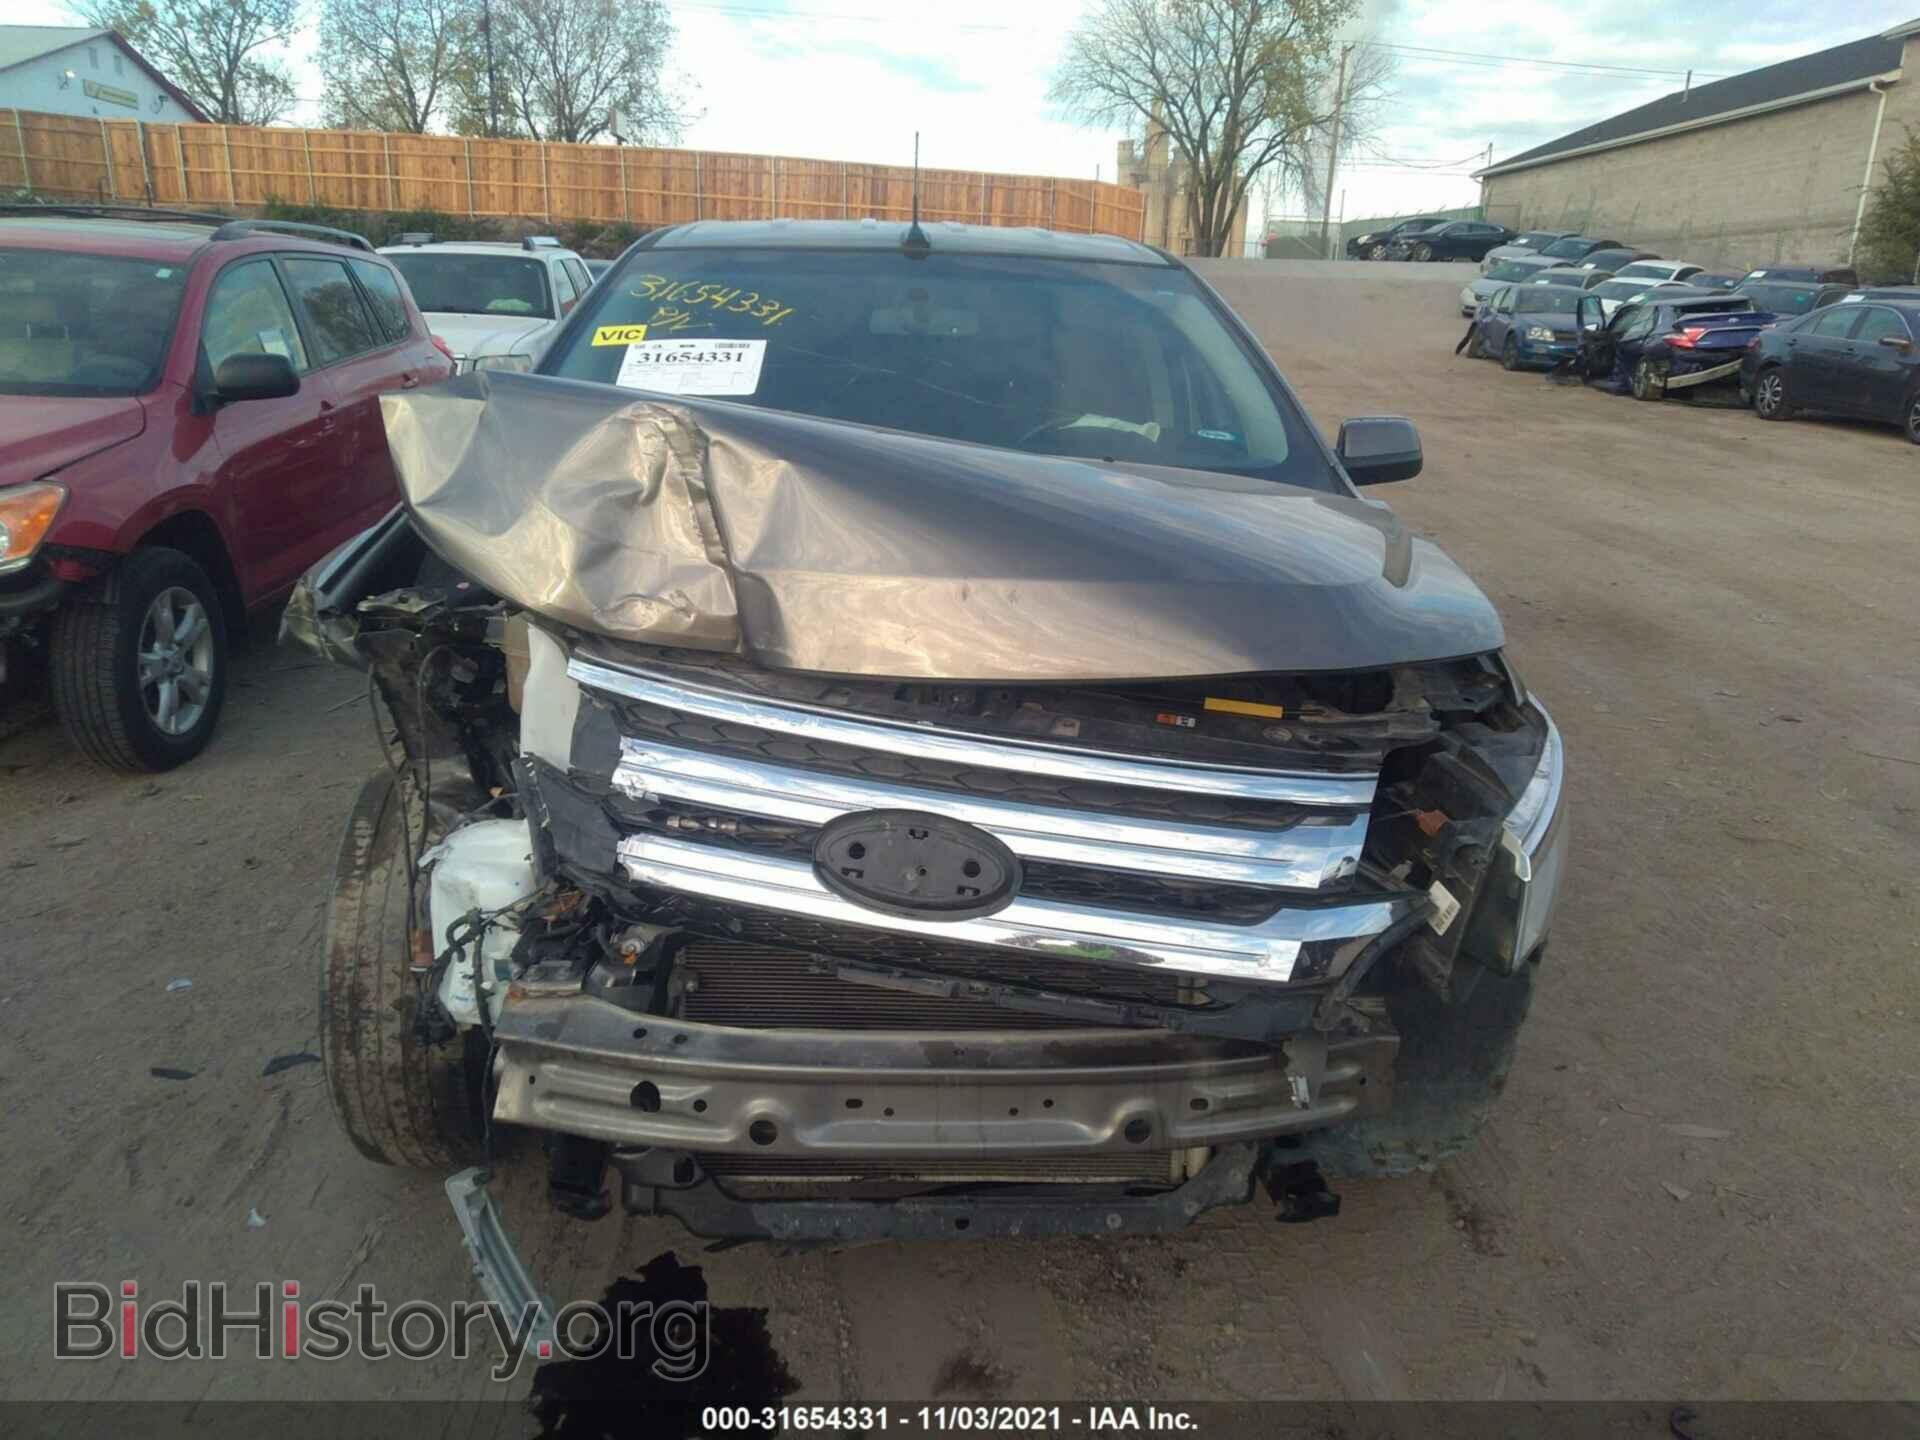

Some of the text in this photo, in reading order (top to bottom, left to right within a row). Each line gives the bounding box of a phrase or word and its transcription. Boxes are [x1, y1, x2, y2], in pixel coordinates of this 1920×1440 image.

[631, 274, 793, 325] 31654331
[600, 329, 642, 341] VIC
[636, 352, 744, 364] 31654331
